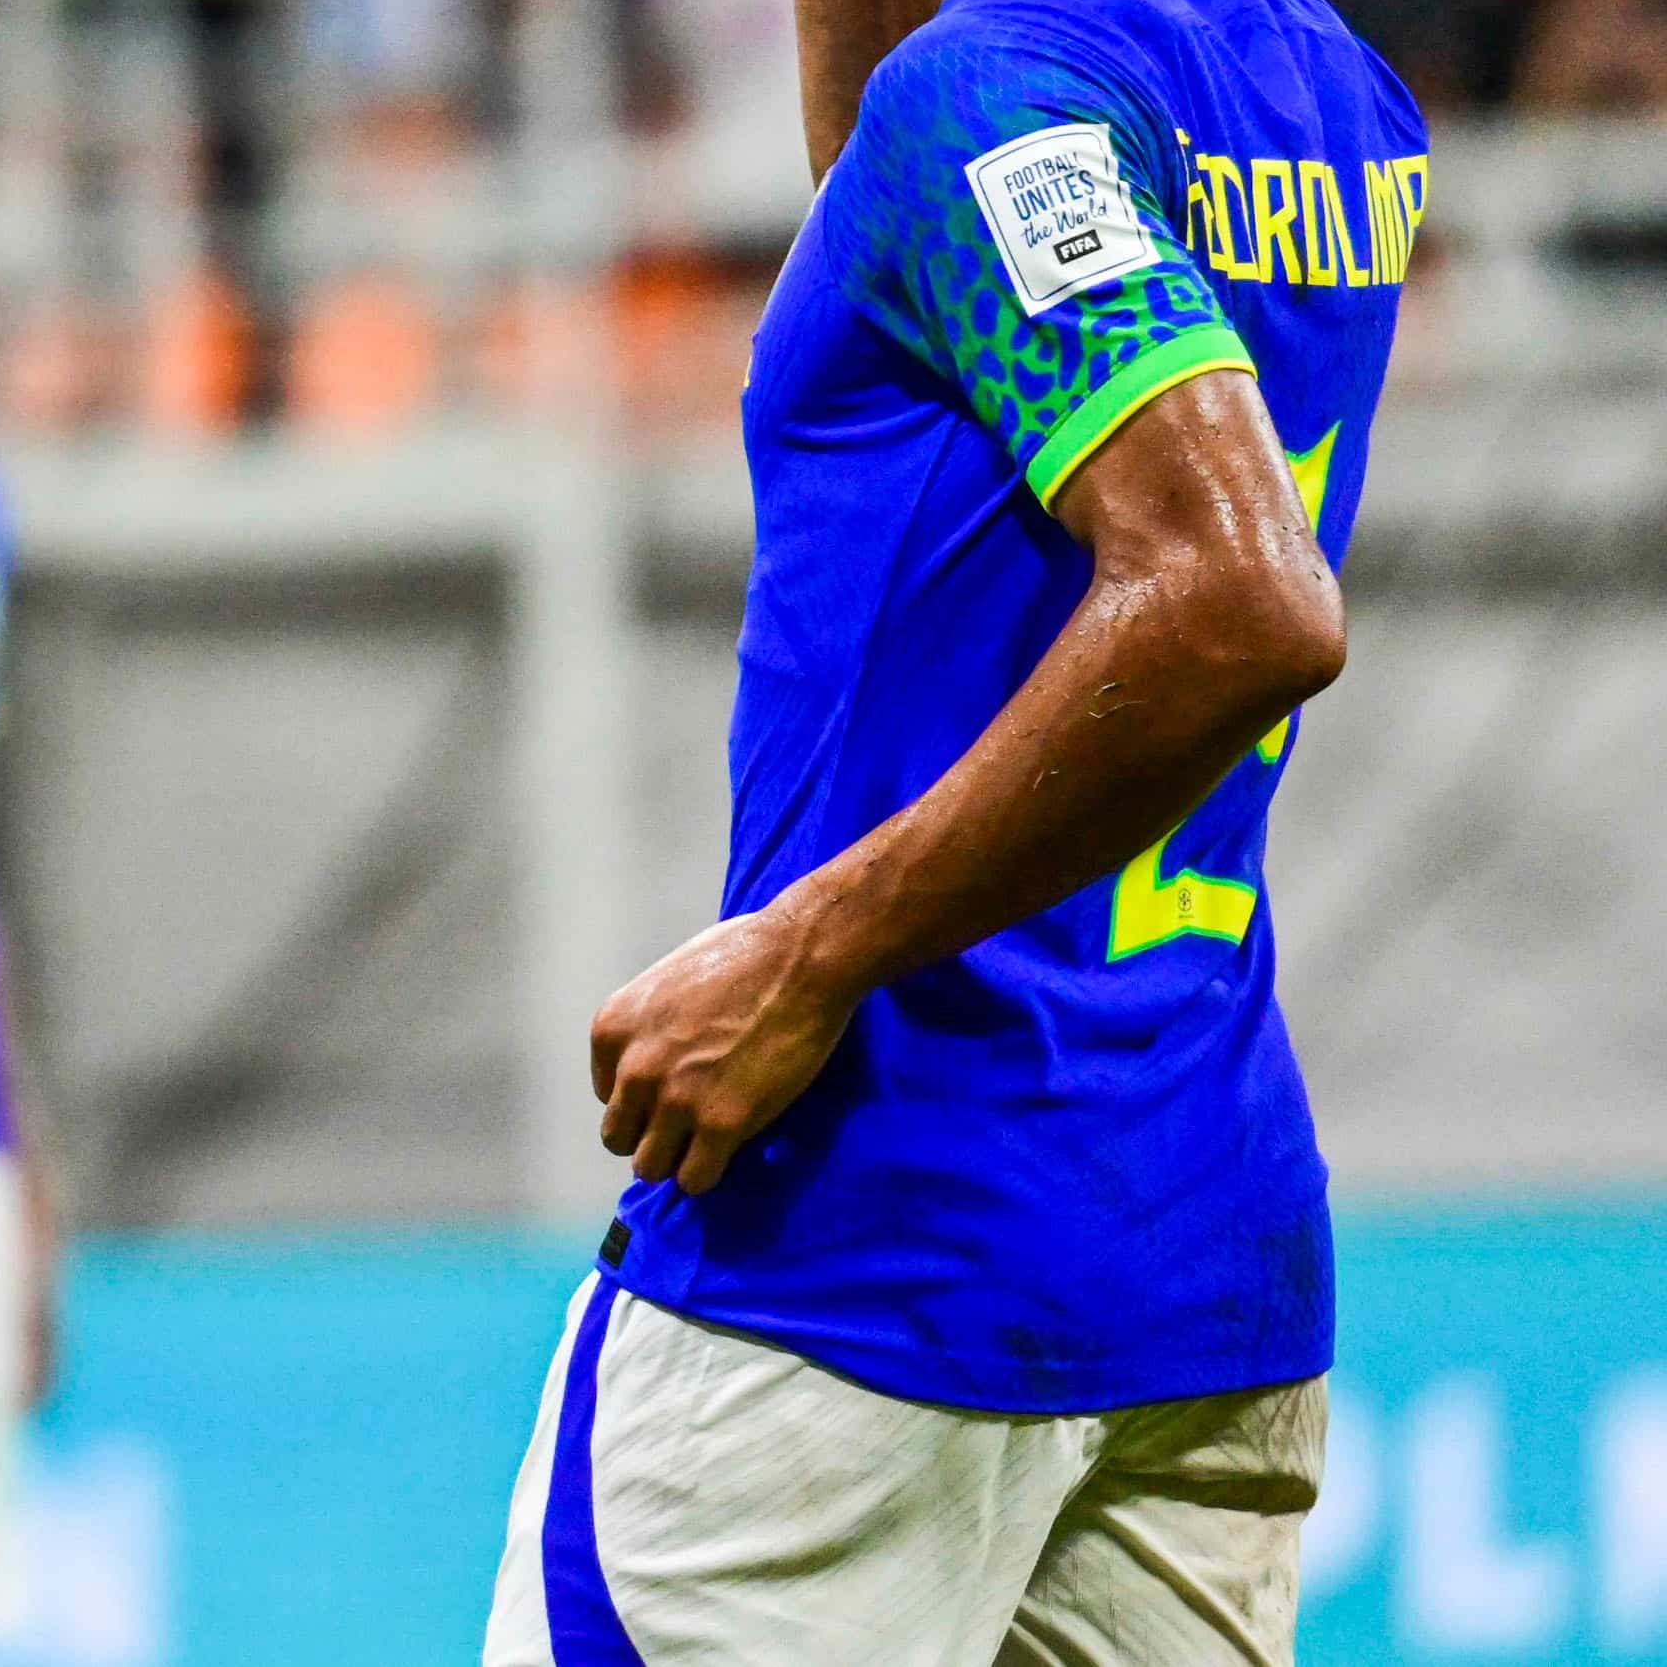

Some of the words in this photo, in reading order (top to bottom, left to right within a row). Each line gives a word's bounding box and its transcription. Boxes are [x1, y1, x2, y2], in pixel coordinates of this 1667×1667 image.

[1012, 169, 1096, 221] UNITES
[1021, 221, 1053, 248] the
[1052, 197, 1107, 233] World
[1058, 234, 1099, 261] FIFA
